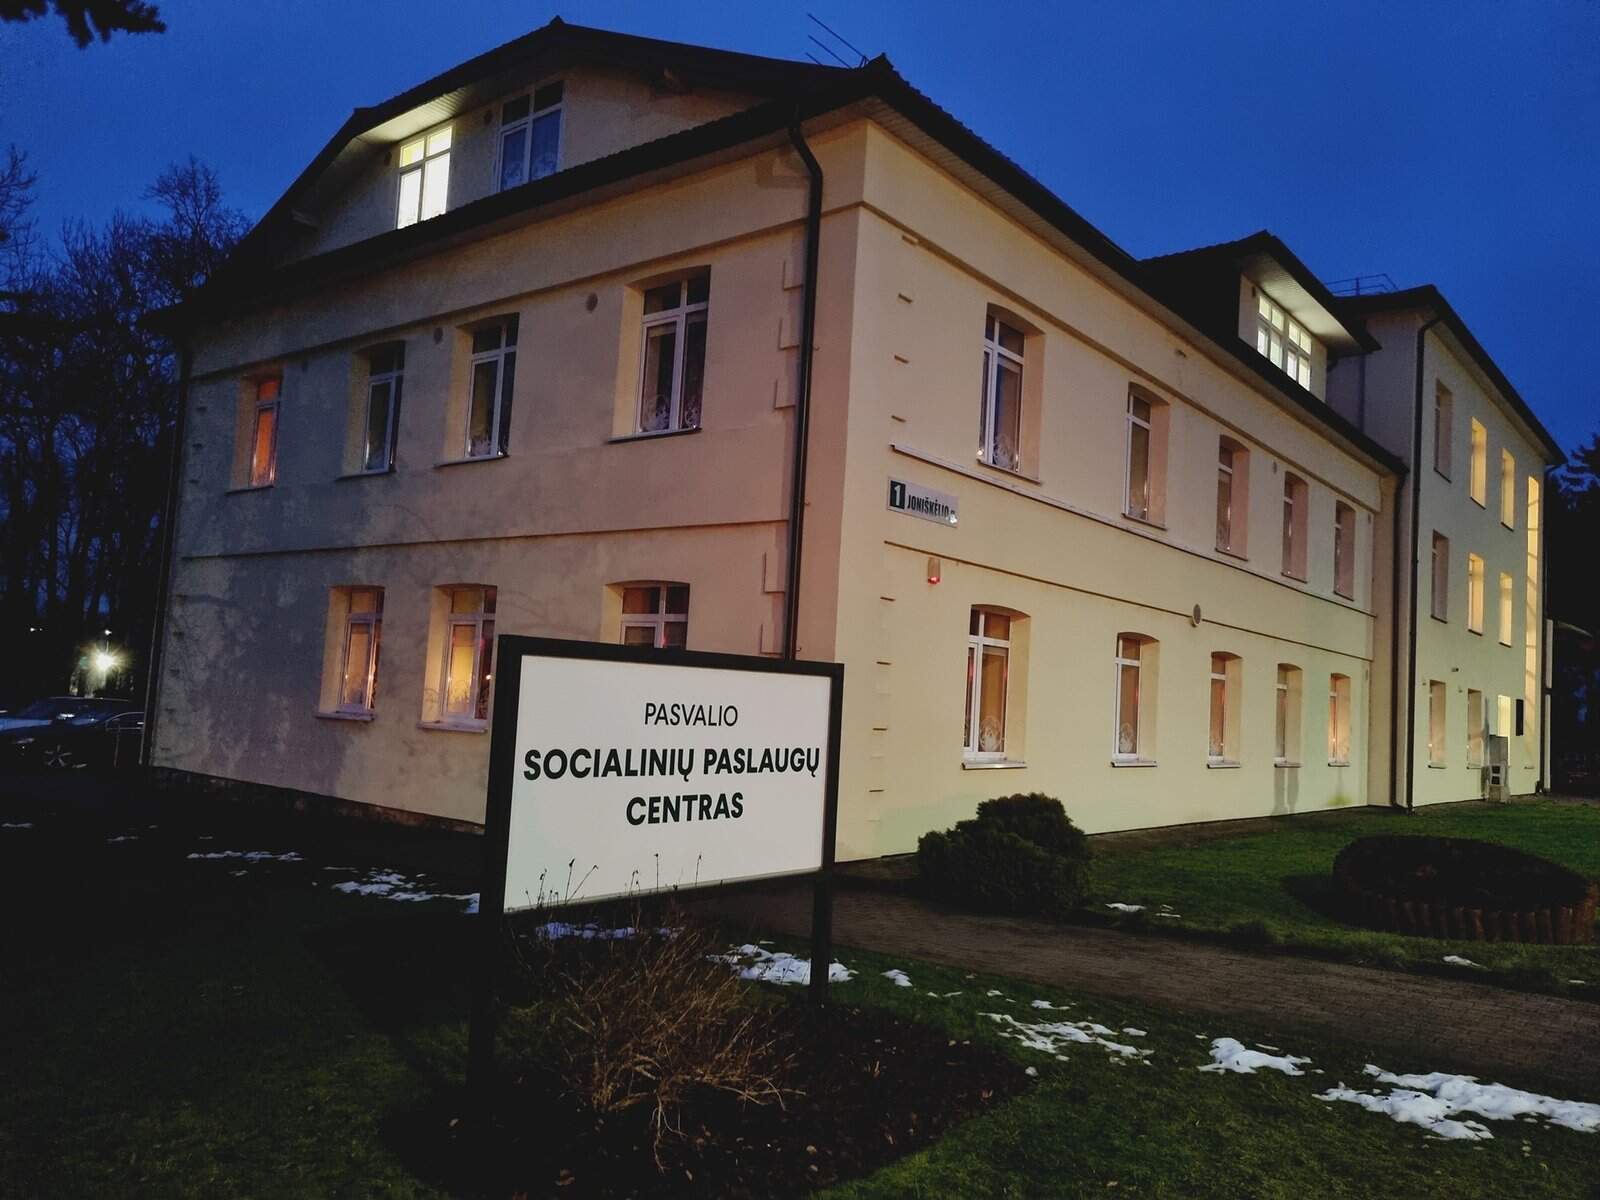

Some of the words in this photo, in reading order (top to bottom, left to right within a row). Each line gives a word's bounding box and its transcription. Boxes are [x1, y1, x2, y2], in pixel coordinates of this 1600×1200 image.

[894, 484, 901, 506] 1
[907, 494, 949, 517] JONIŠKĖLIO
[644, 702, 738, 727] PASVALIO
[523, 748, 695, 782] SOCIALINIŲ
[703, 747, 820, 778] PASLAUGŲ
[626, 792, 744, 826] CENTRAS
